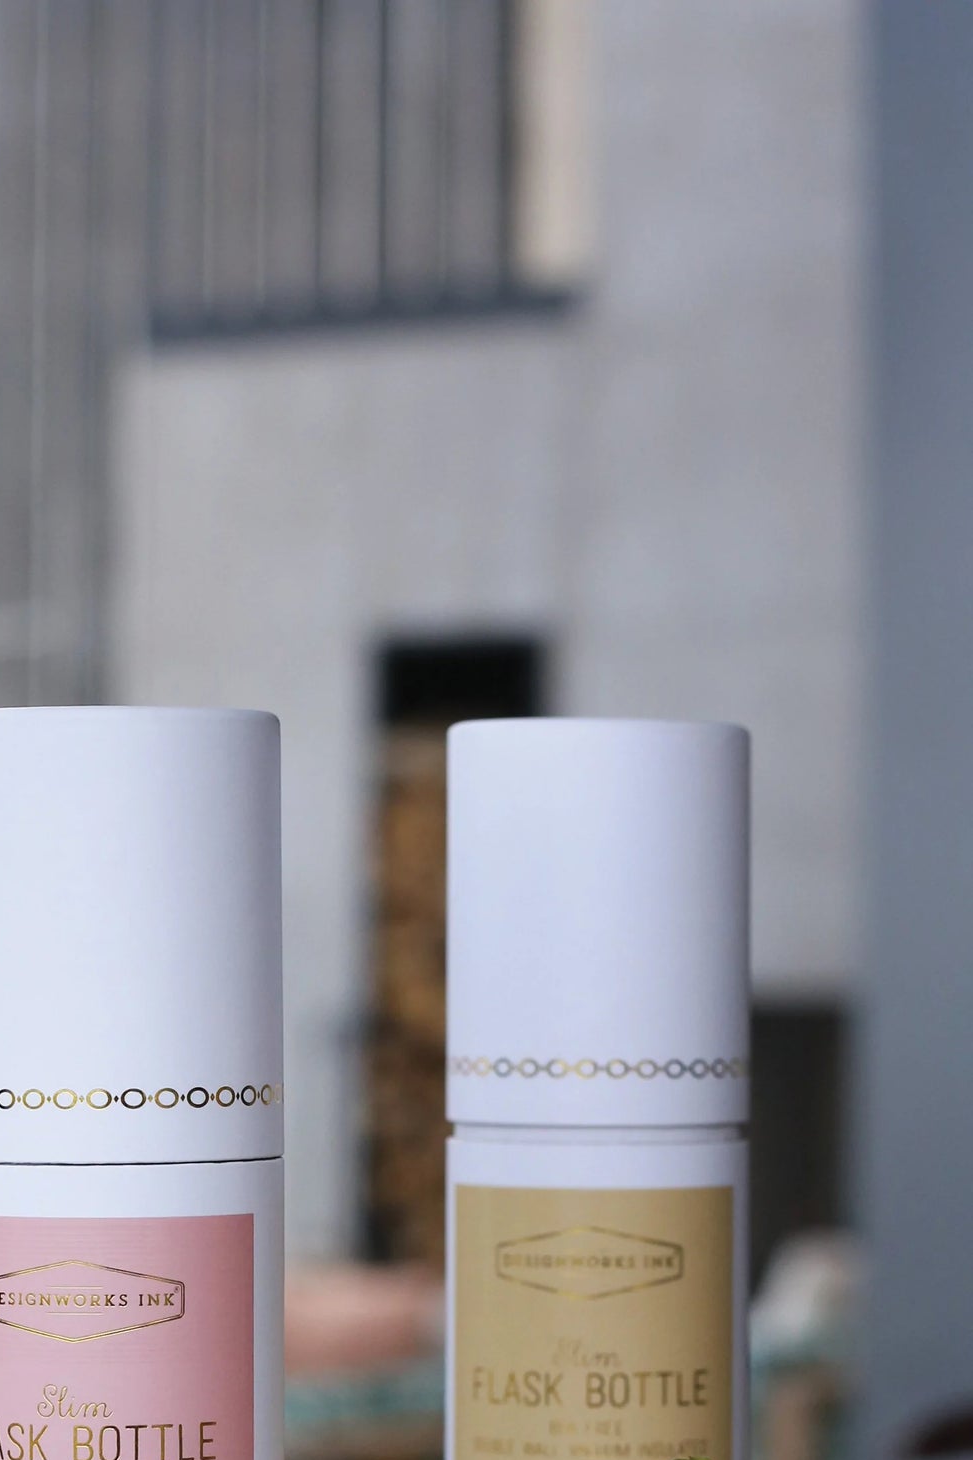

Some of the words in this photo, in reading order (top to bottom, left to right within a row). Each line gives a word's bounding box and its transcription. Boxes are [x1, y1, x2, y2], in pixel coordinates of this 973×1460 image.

[37, 1384, 113, 1418] Slim
[472, 1367, 564, 1407] FLASK
[585, 1369, 708, 1409] BOTTLE
